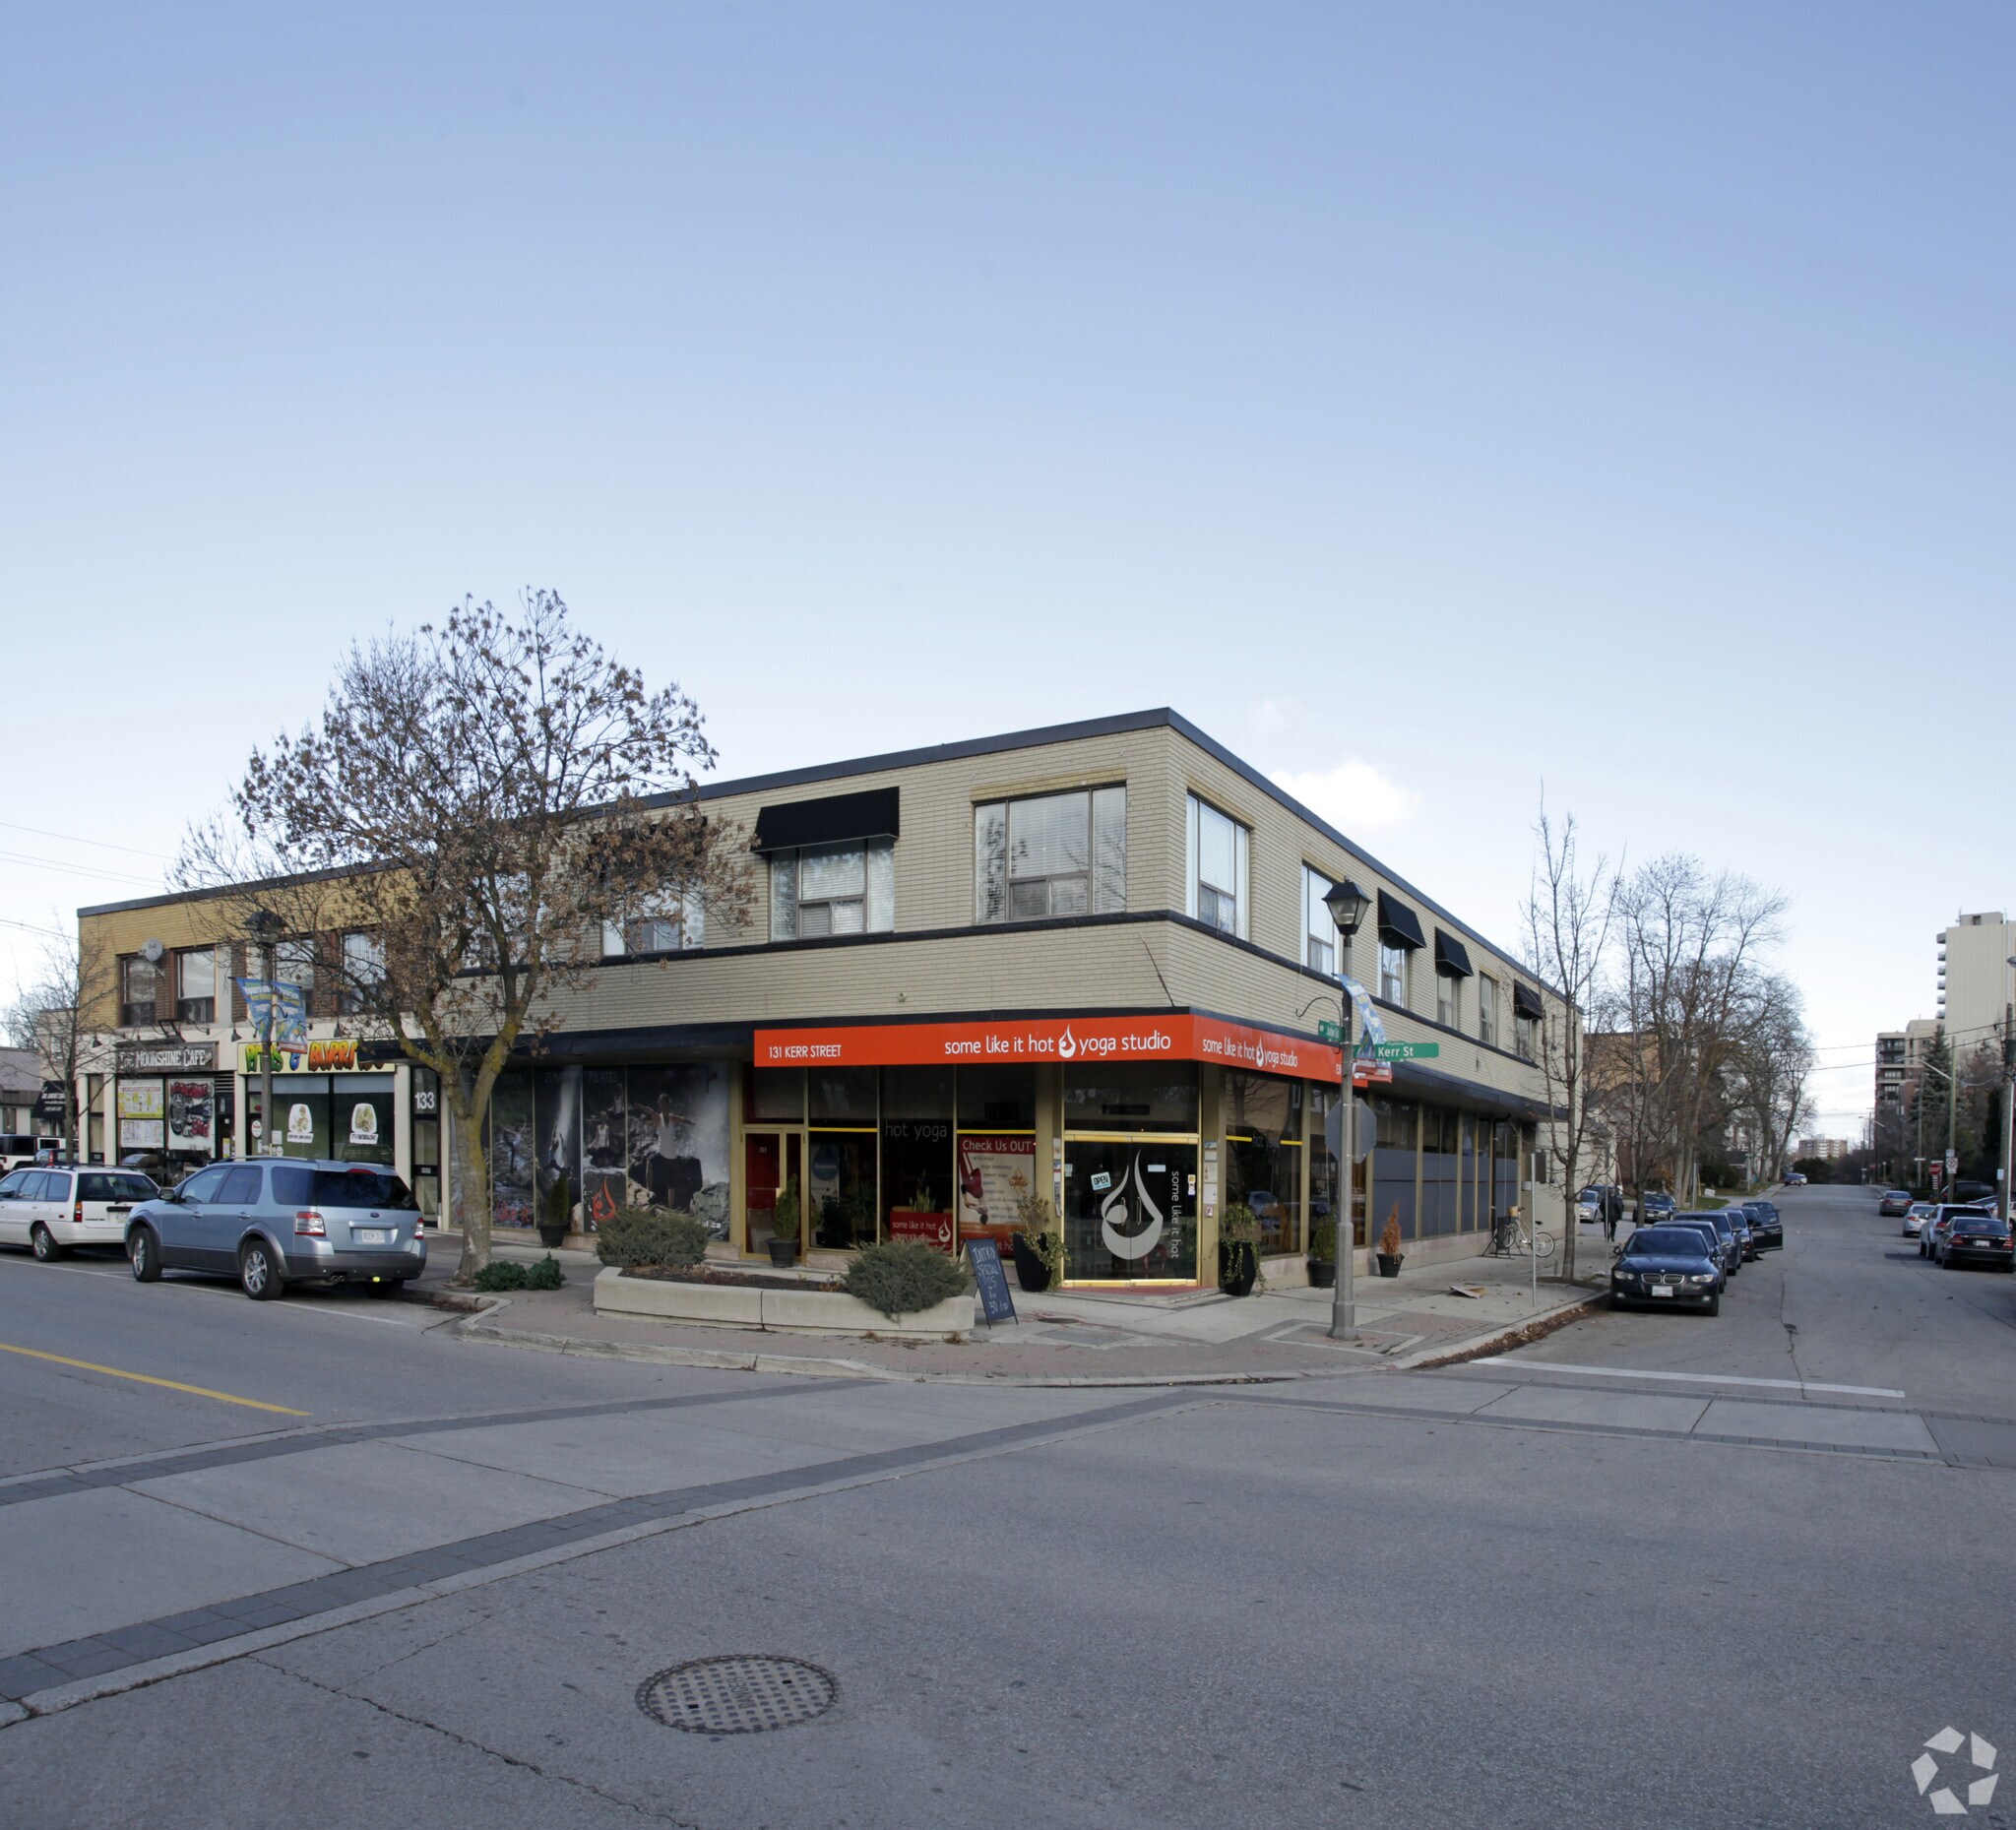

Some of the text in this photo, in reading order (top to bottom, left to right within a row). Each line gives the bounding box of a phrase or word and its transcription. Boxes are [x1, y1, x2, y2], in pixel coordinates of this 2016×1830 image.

[769, 1044, 842, 1059] 131 KERR STREET
[944, 1030, 1171, 1056] some like it hot yoga studio
[1377, 1045, 1414, 1057] Kerr St
[136, 1049, 181, 1068] MOONSHINE
[183, 1049, 207, 1067] CAFE
[1202, 1037, 1297, 1068] some like it hot yoga studio
[589, 1071, 618, 1083] PILATES
[414, 1092, 435, 1109] 133
[886, 1122, 947, 1142] hot yoga
[962, 1139, 1032, 1152] Check Us OUT
[1093, 1174, 1108, 1186] OPEN
[1170, 1170, 1181, 1259] some like it hot
[909, 1221, 919, 1230] like
[920, 1221, 925, 1230] it
[925, 1222, 936, 1231] hot
[1004, 1240, 1014, 1251] ho
[972, 1246, 996, 1264] INTRO
[726, 1676, 756, 1709] DANGER
